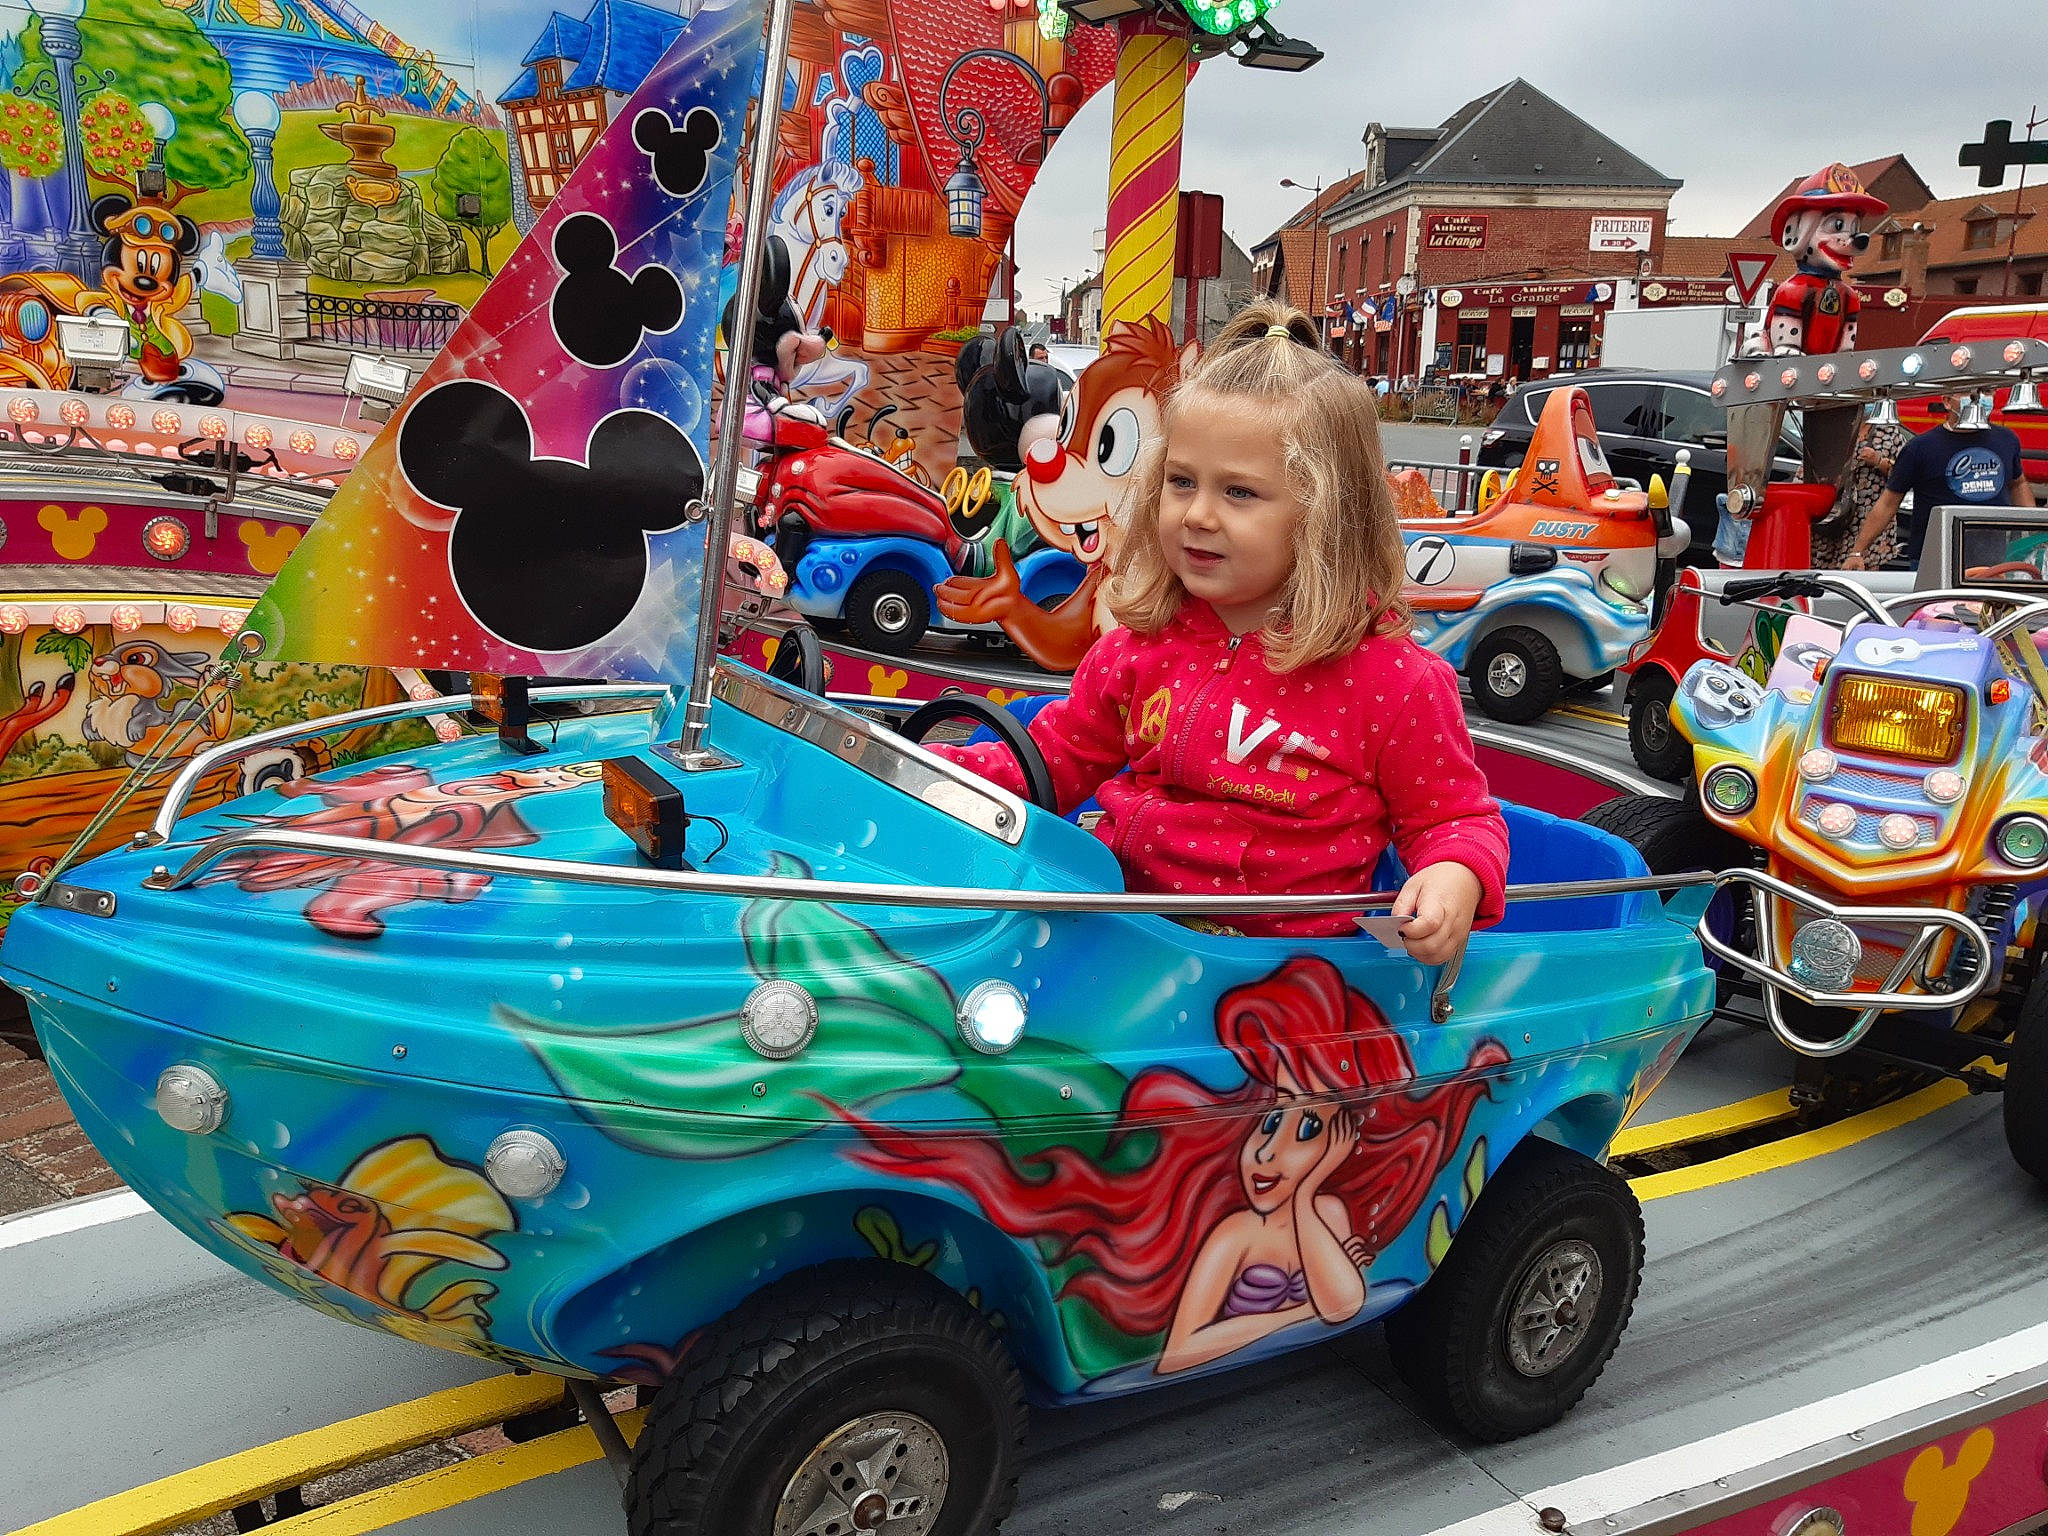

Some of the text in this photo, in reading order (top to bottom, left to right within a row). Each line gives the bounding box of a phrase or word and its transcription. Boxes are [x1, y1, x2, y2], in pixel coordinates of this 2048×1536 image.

[1444, 216, 1471, 224] Café
[1593, 219, 1650, 233] FRITERIE
[1431, 223, 1484, 233] Auberge
[1429, 234, 1483, 249] La Grange
[1473, 285, 1575, 295] Café Auberge
[1489, 292, 1561, 304] La Grange
[1962, 480, 1994, 490] DENIM
[1528, 519, 1600, 539] DUSTY
[1415, 540, 1446, 582] 7
